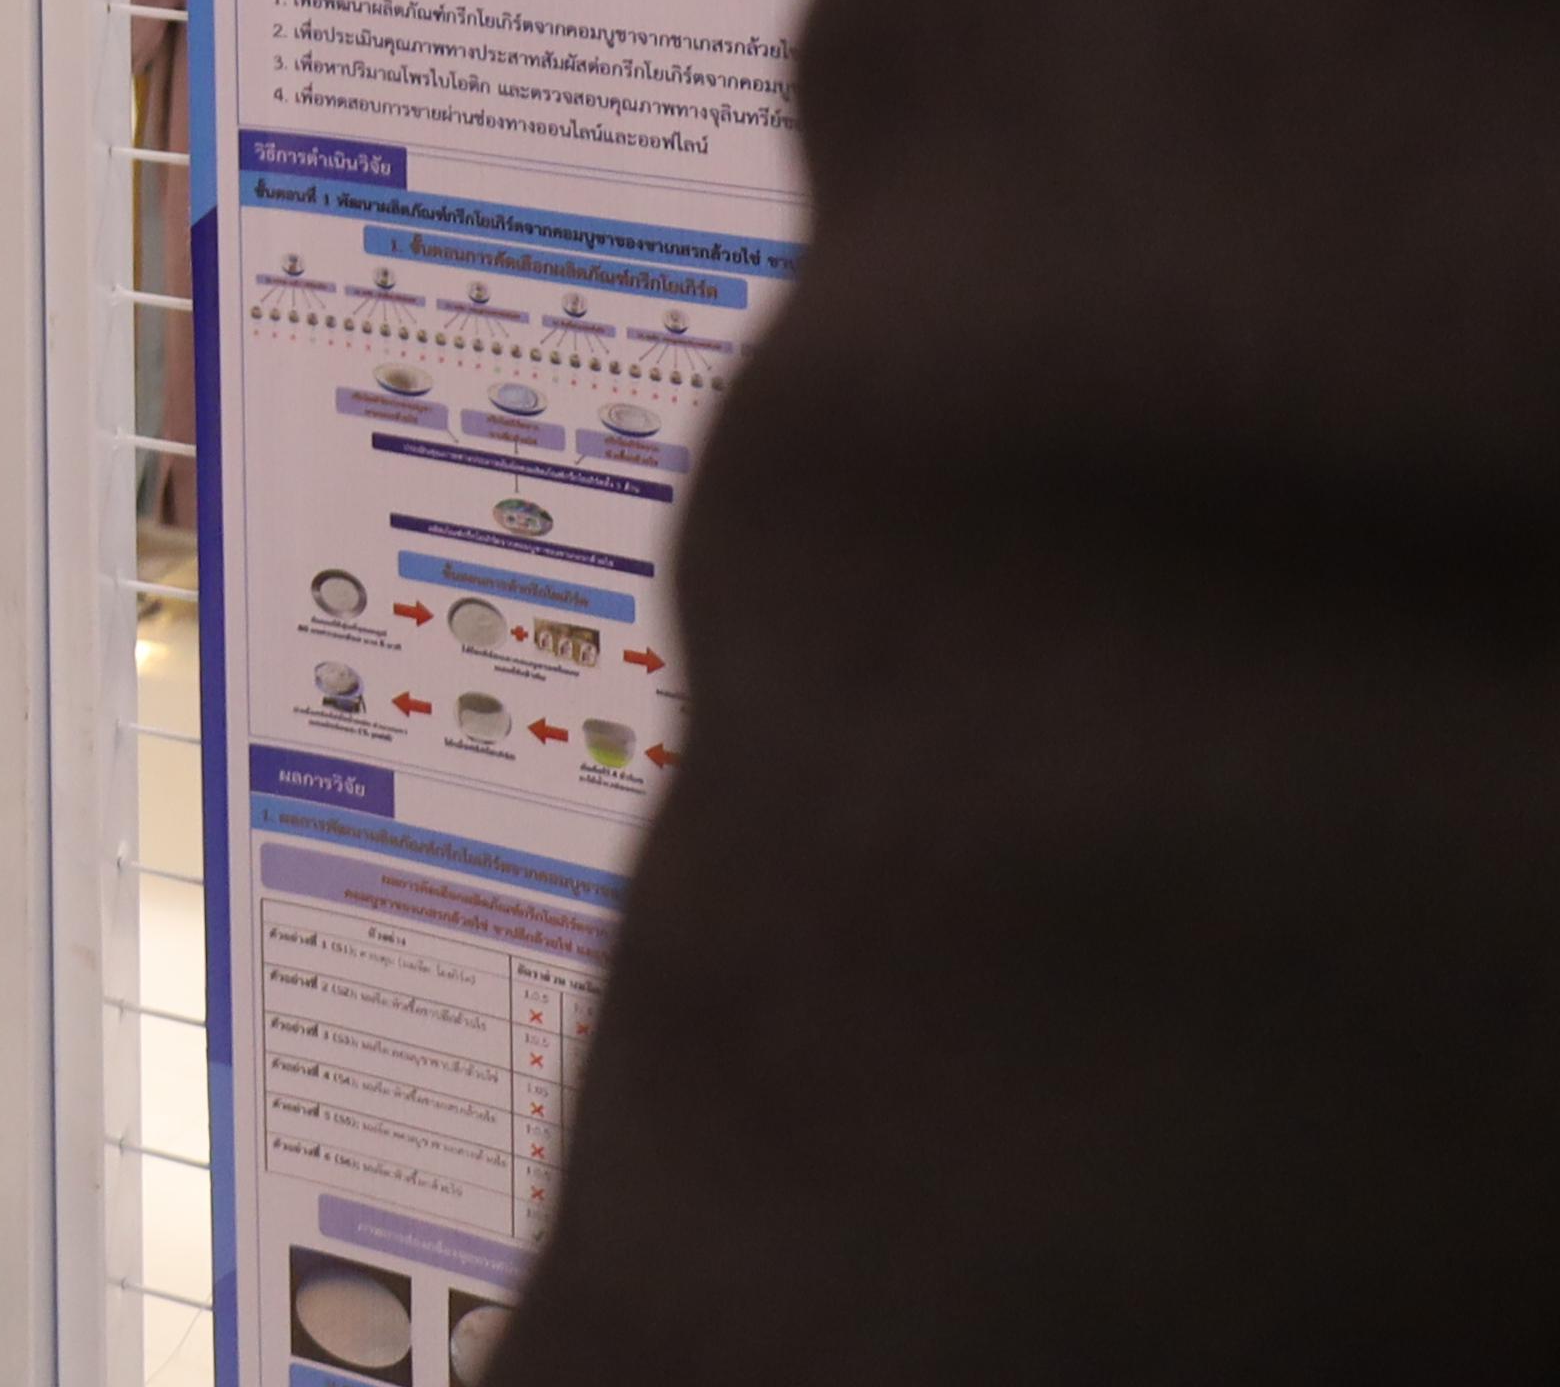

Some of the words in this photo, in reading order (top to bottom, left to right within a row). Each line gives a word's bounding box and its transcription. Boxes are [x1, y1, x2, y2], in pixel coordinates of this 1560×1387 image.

[273, 23, 287, 38] 2.
[273, 56, 288, 71] 3.
[294, 50, 491, 95] เพื่อหาปริมาณโพรไบโอติก
[273, 87, 289, 103] 4.
[253, 142, 392, 176] วิธีการดำเนินวิจัย
[279, 768, 366, 798] ผลการวิจัย
